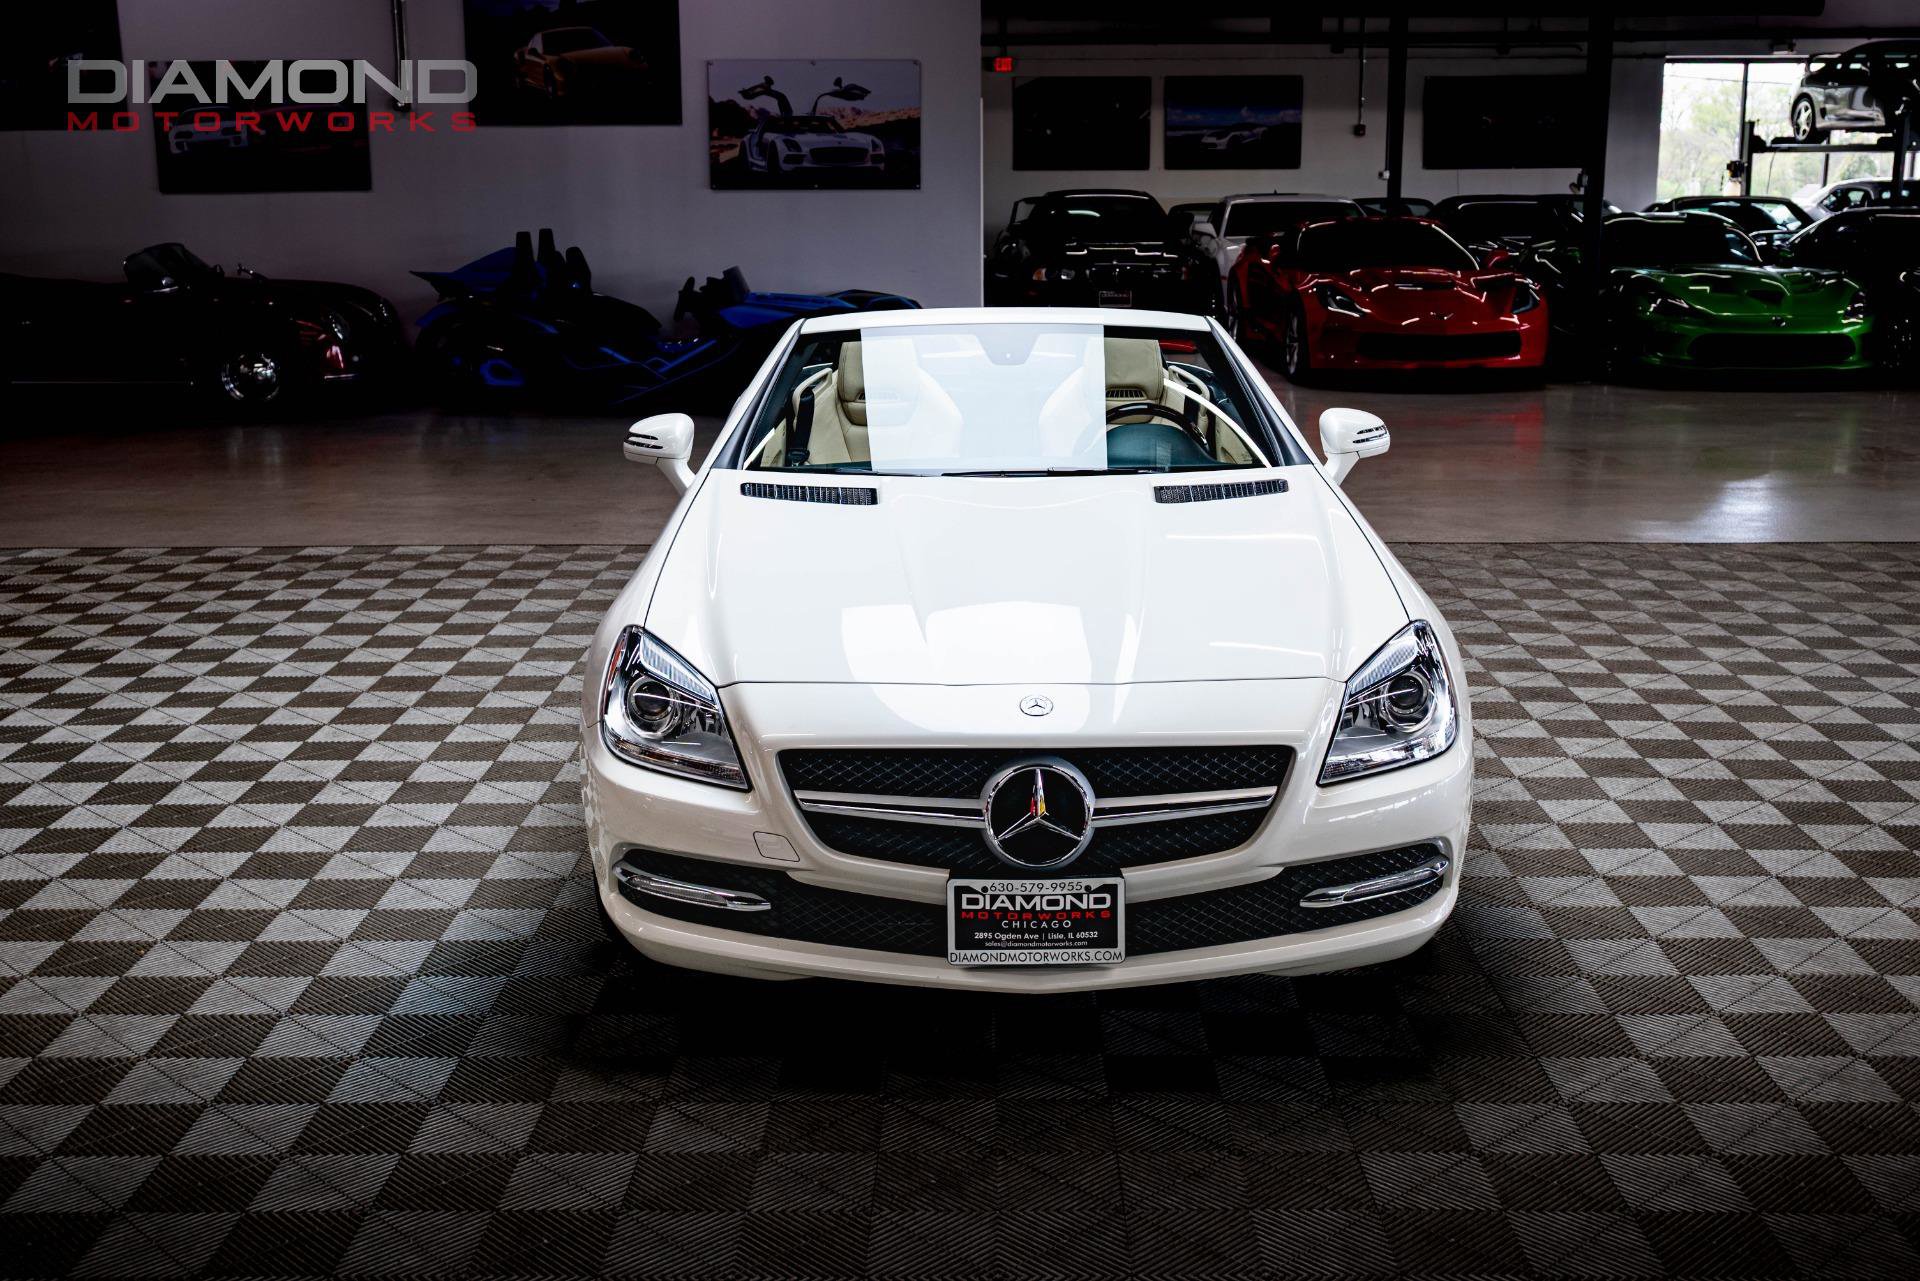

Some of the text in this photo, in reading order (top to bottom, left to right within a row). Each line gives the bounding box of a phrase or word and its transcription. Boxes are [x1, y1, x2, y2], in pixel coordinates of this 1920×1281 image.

[989, 881, 1083, 893] 630-579-9955
[961, 893, 1112, 911] DIAMOND
[961, 910, 1111, 920] MOTORWORKS
[1001, 920, 1072, 929] CHICAGO
[974, 932, 993, 940] 2895
[994, 932, 1022, 941] Ogden
[1023, 932, 1039, 940] Ave
[1068, 932, 1074, 940] IL
[1076, 931, 1099, 940] 60532
[984, 940, 1088, 948] sales@diamondmotorworks.com
[949, 951, 1123, 964] DIAMONDMOTORWORKS.COM
